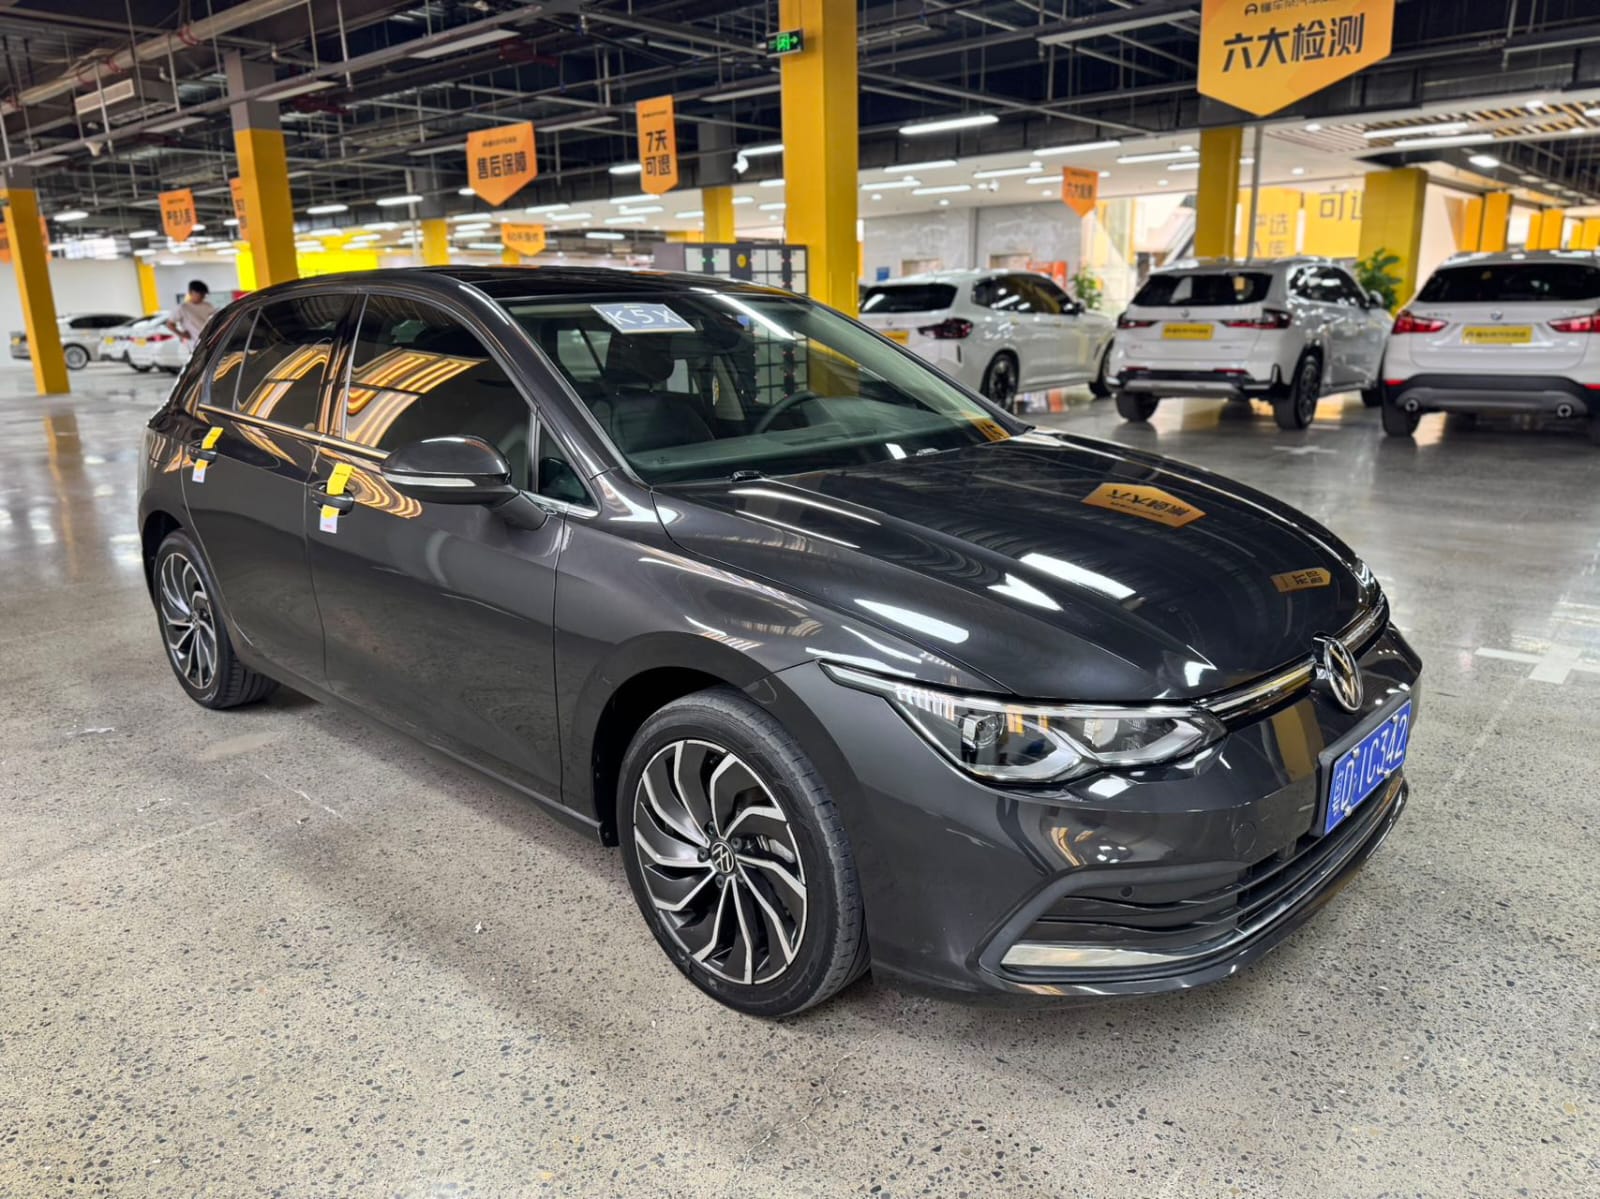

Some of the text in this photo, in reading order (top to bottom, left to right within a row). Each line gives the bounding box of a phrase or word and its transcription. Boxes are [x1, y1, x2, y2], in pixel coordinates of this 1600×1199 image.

[1222, 12, 1365, 73] 六大检测
[645, 129, 667, 153] 7天
[477, 151, 527, 180] 售后保障
[645, 154, 671, 176] 可退
[606, 308, 681, 325] K5X
